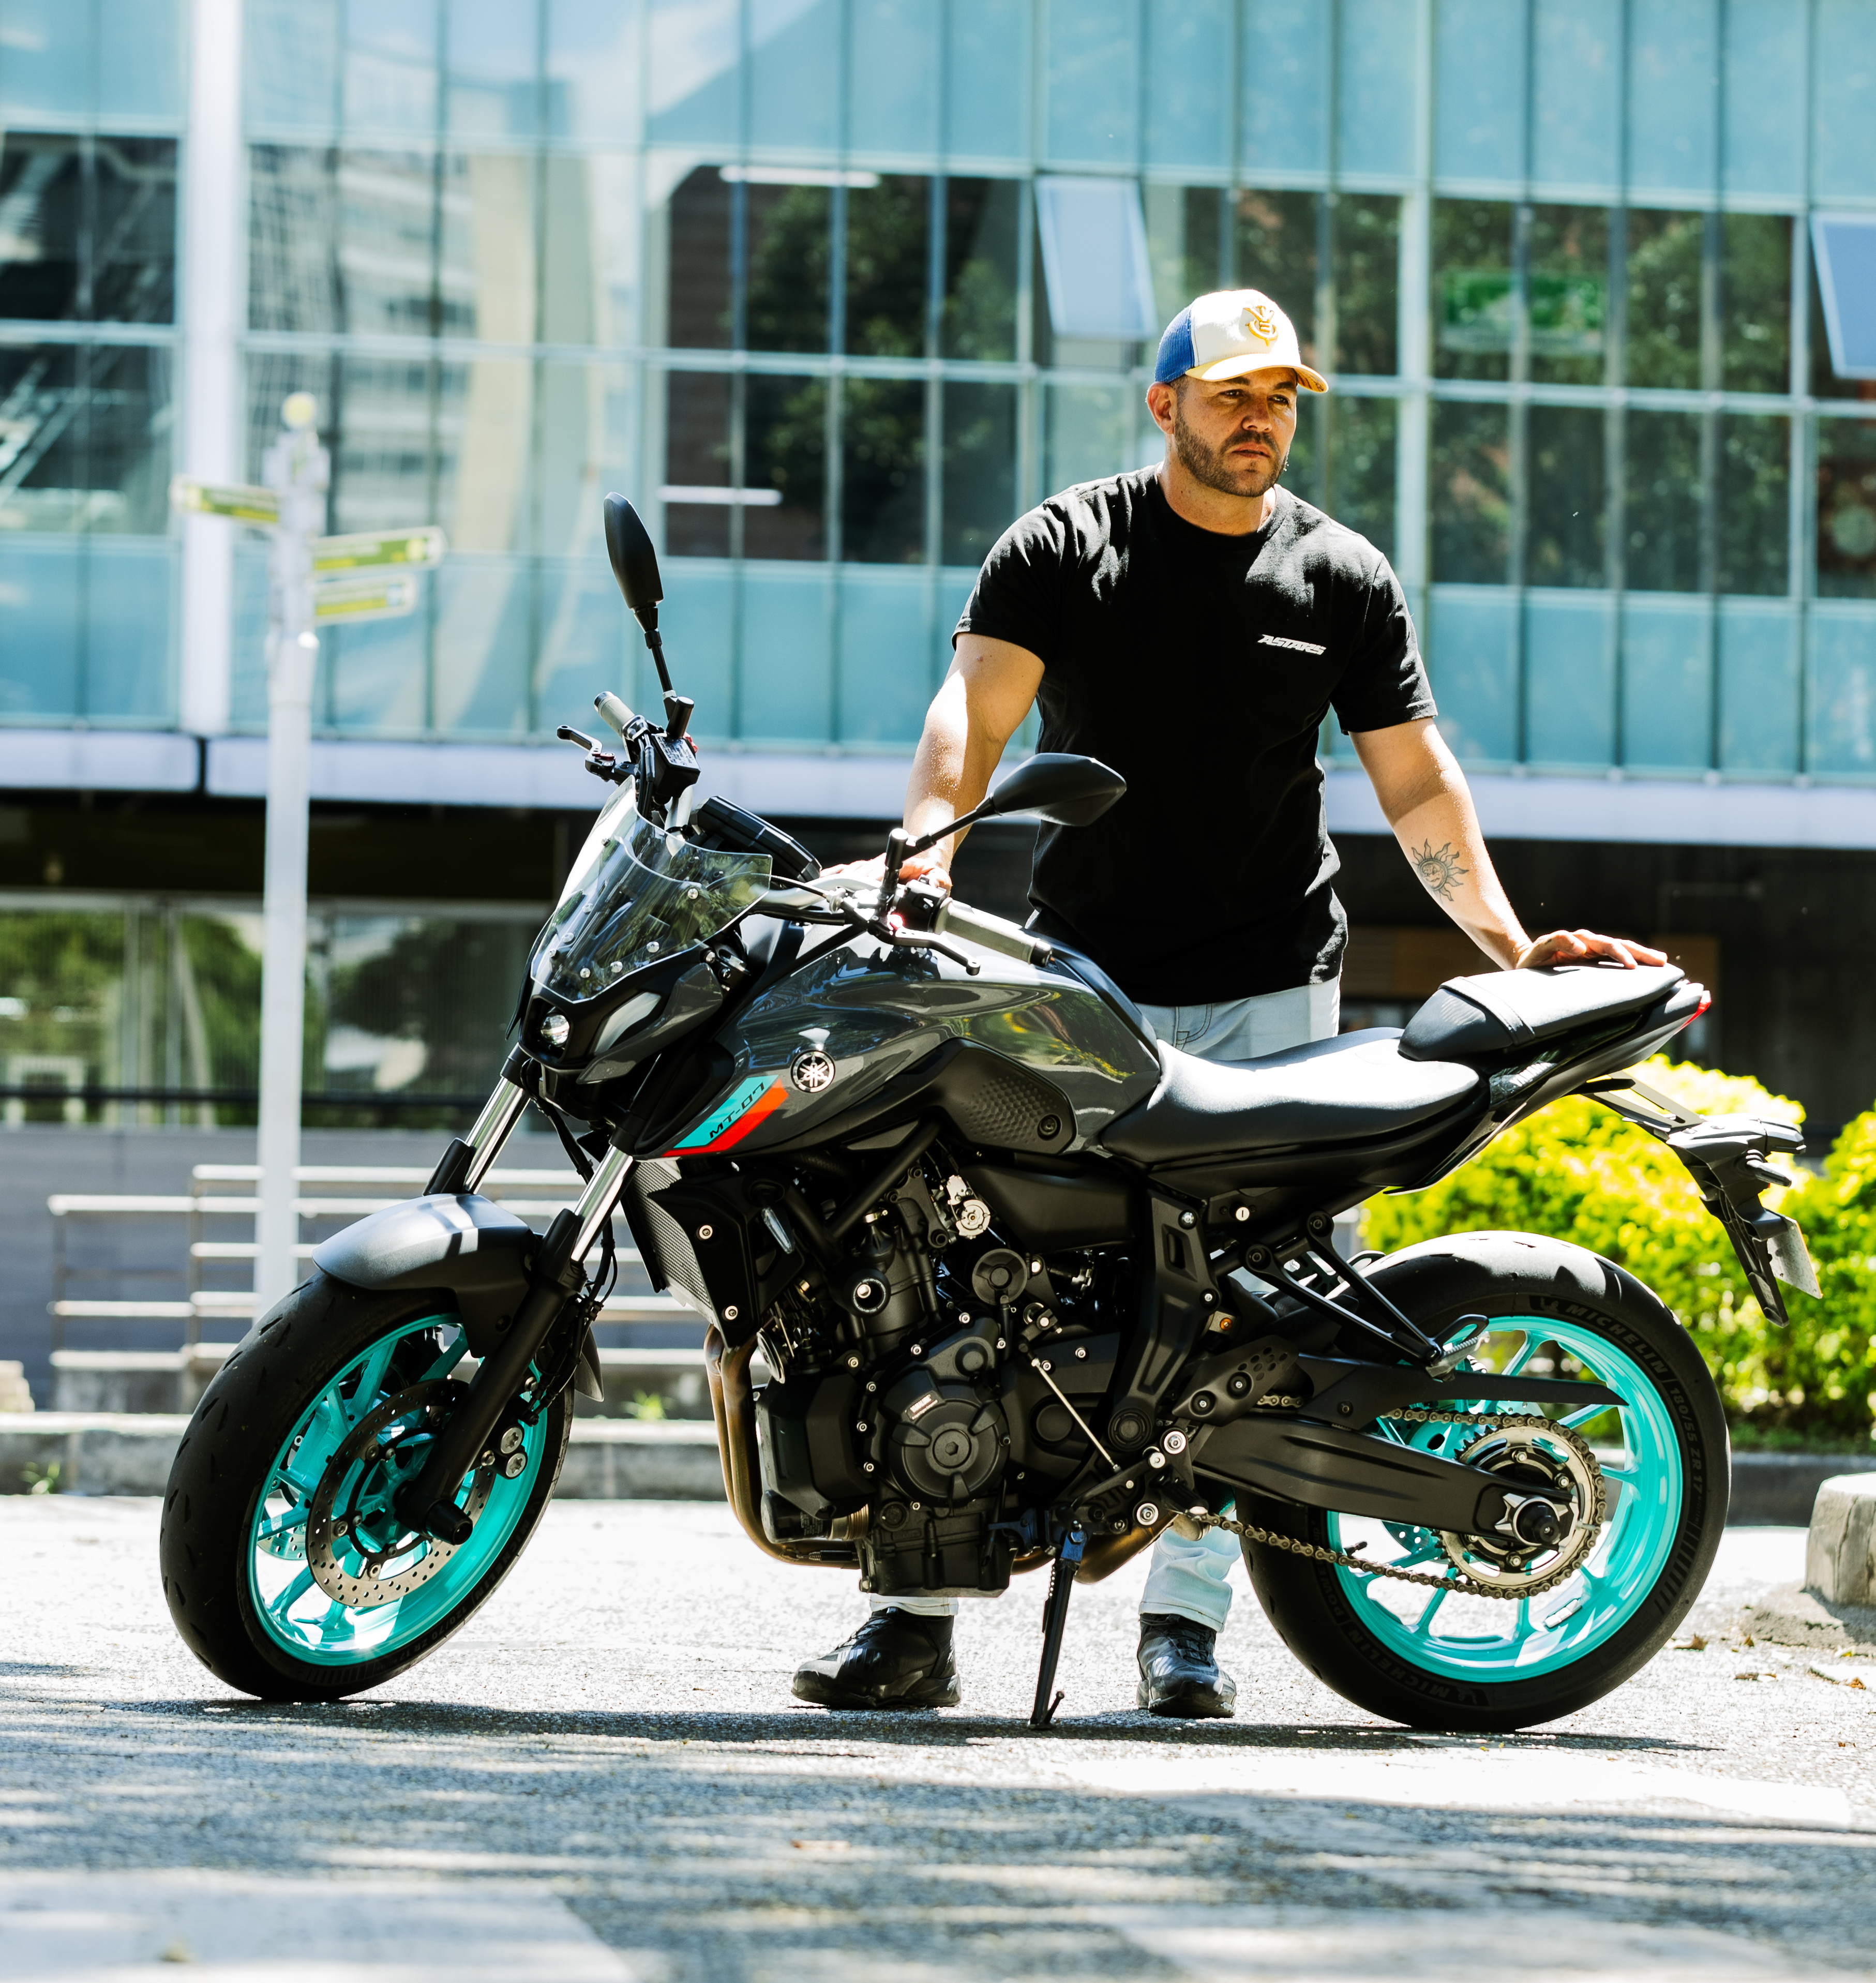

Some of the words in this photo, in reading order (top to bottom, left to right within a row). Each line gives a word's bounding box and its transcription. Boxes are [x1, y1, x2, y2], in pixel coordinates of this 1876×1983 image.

[1257, 634, 1327, 655] ASTARS
[710, 1082, 764, 1138] MT-07
[1565, 1304, 1668, 1373] MICHELIN
[1670, 1388, 1698, 1442] 180/55
[1690, 1447, 1702, 1470] ZR
[1693, 1476, 1703, 1494] 17
[475, 1520, 530, 1600] MICHELIN
[1318, 1560, 1344, 1616] POWE
[414, 1639, 428, 1652] ZR
[432, 1605, 467, 1640] 120/70
[1348, 1629, 1450, 1698] MICHELIN
